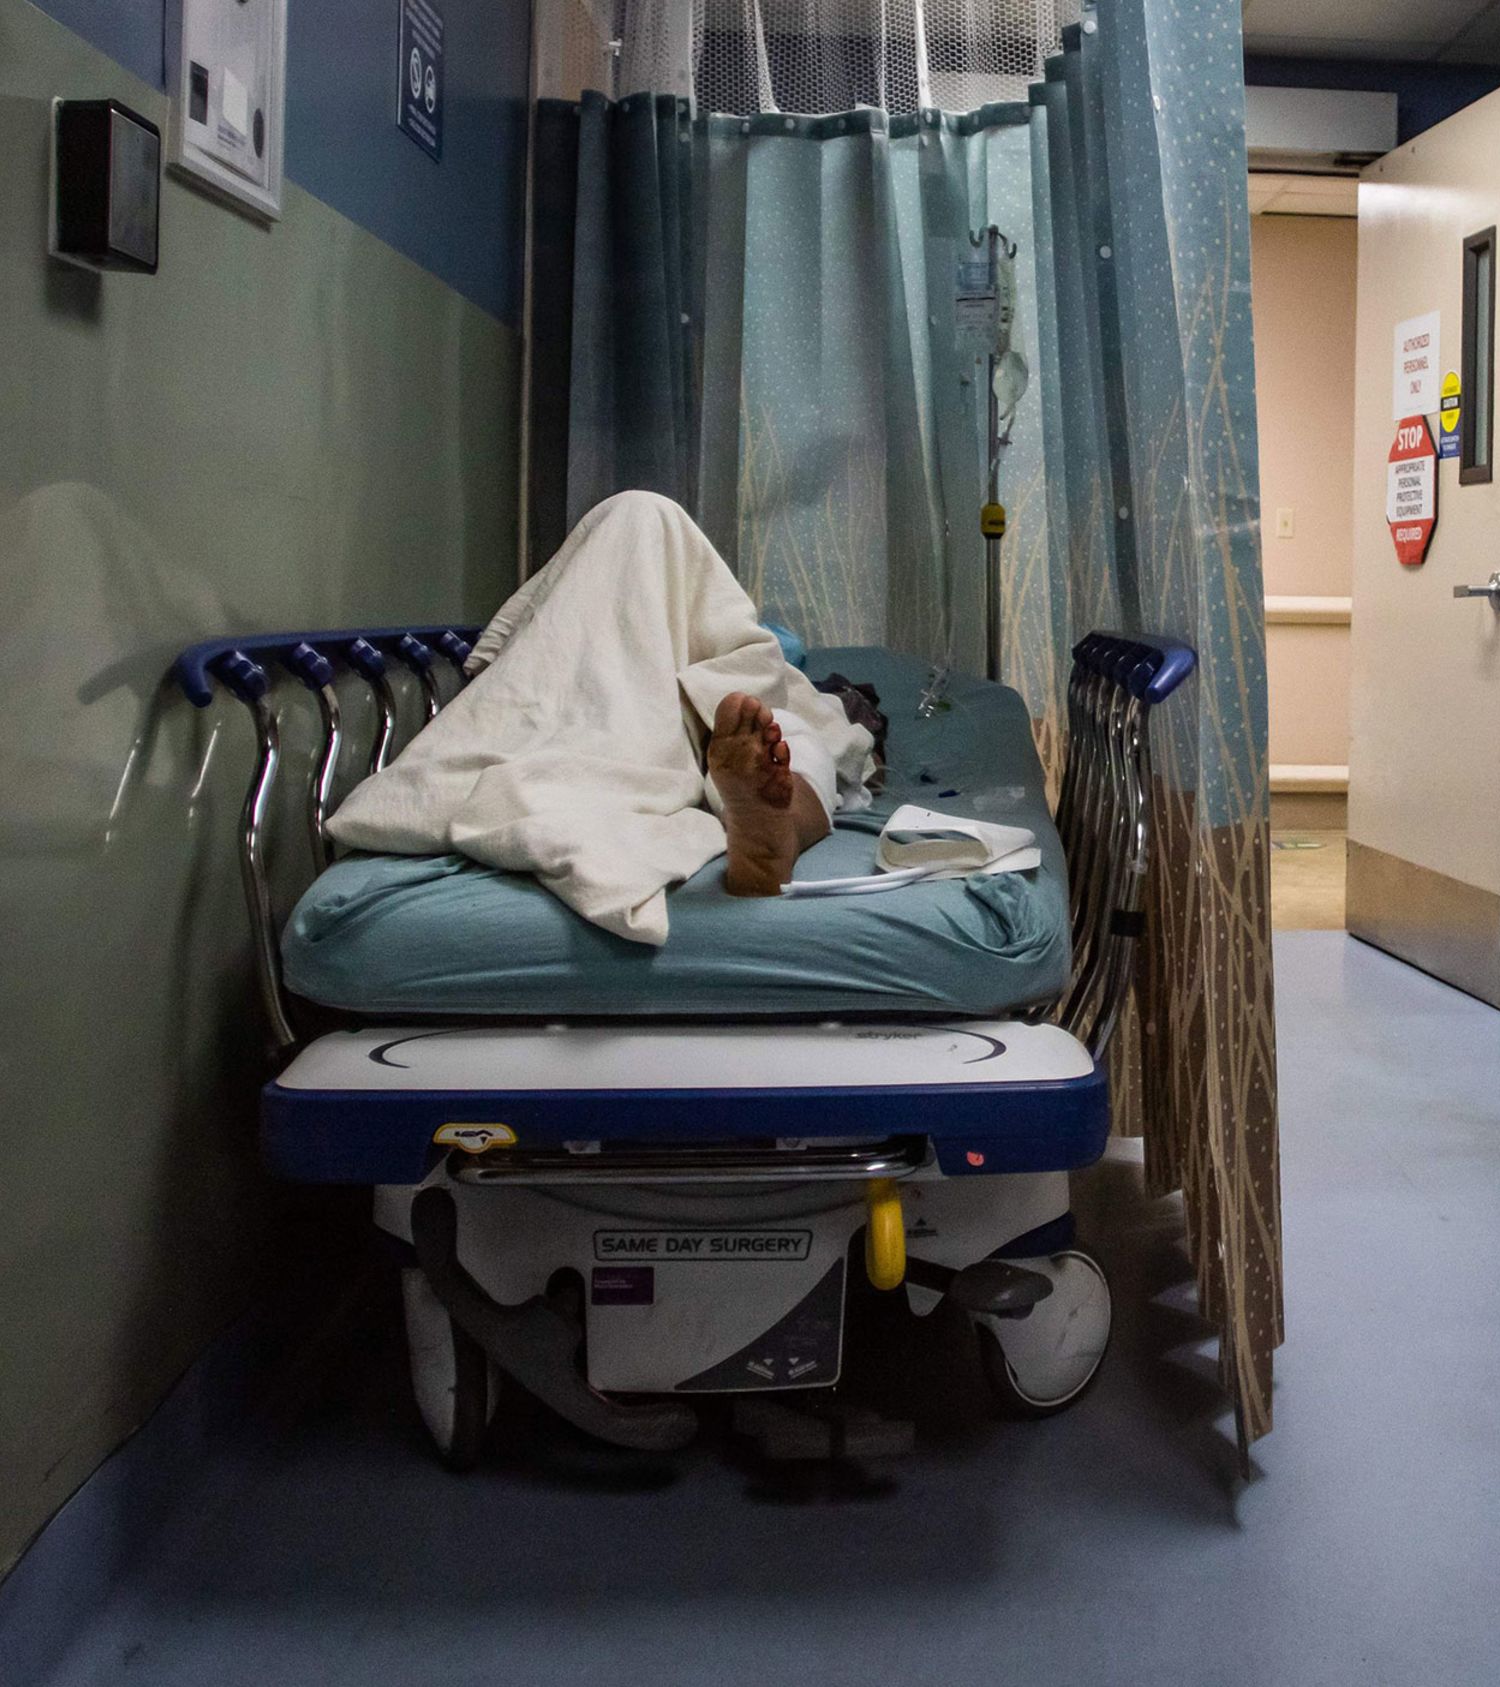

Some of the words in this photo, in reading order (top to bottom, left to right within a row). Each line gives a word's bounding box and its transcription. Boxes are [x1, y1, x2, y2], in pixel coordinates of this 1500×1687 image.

[1403, 333, 1430, 353] AUTHORIZED
[1403, 355, 1429, 374] PERSONNEL
[1397, 425, 1423, 451] STOP
[1395, 460, 1426, 475] APPROPRIATE
[1398, 476, 1422, 488] PERSONAL
[1396, 490, 1423, 502] PROTECTIVE
[1396, 504, 1423, 518] EQUIPMENT
[1396, 527, 1423, 543] REQUIRED
[855, 1030, 923, 1041] stryker
[601, 1237, 658, 1253] SAME
[665, 1237, 704, 1252] DAY
[709, 1237, 803, 1252] SURGERY
